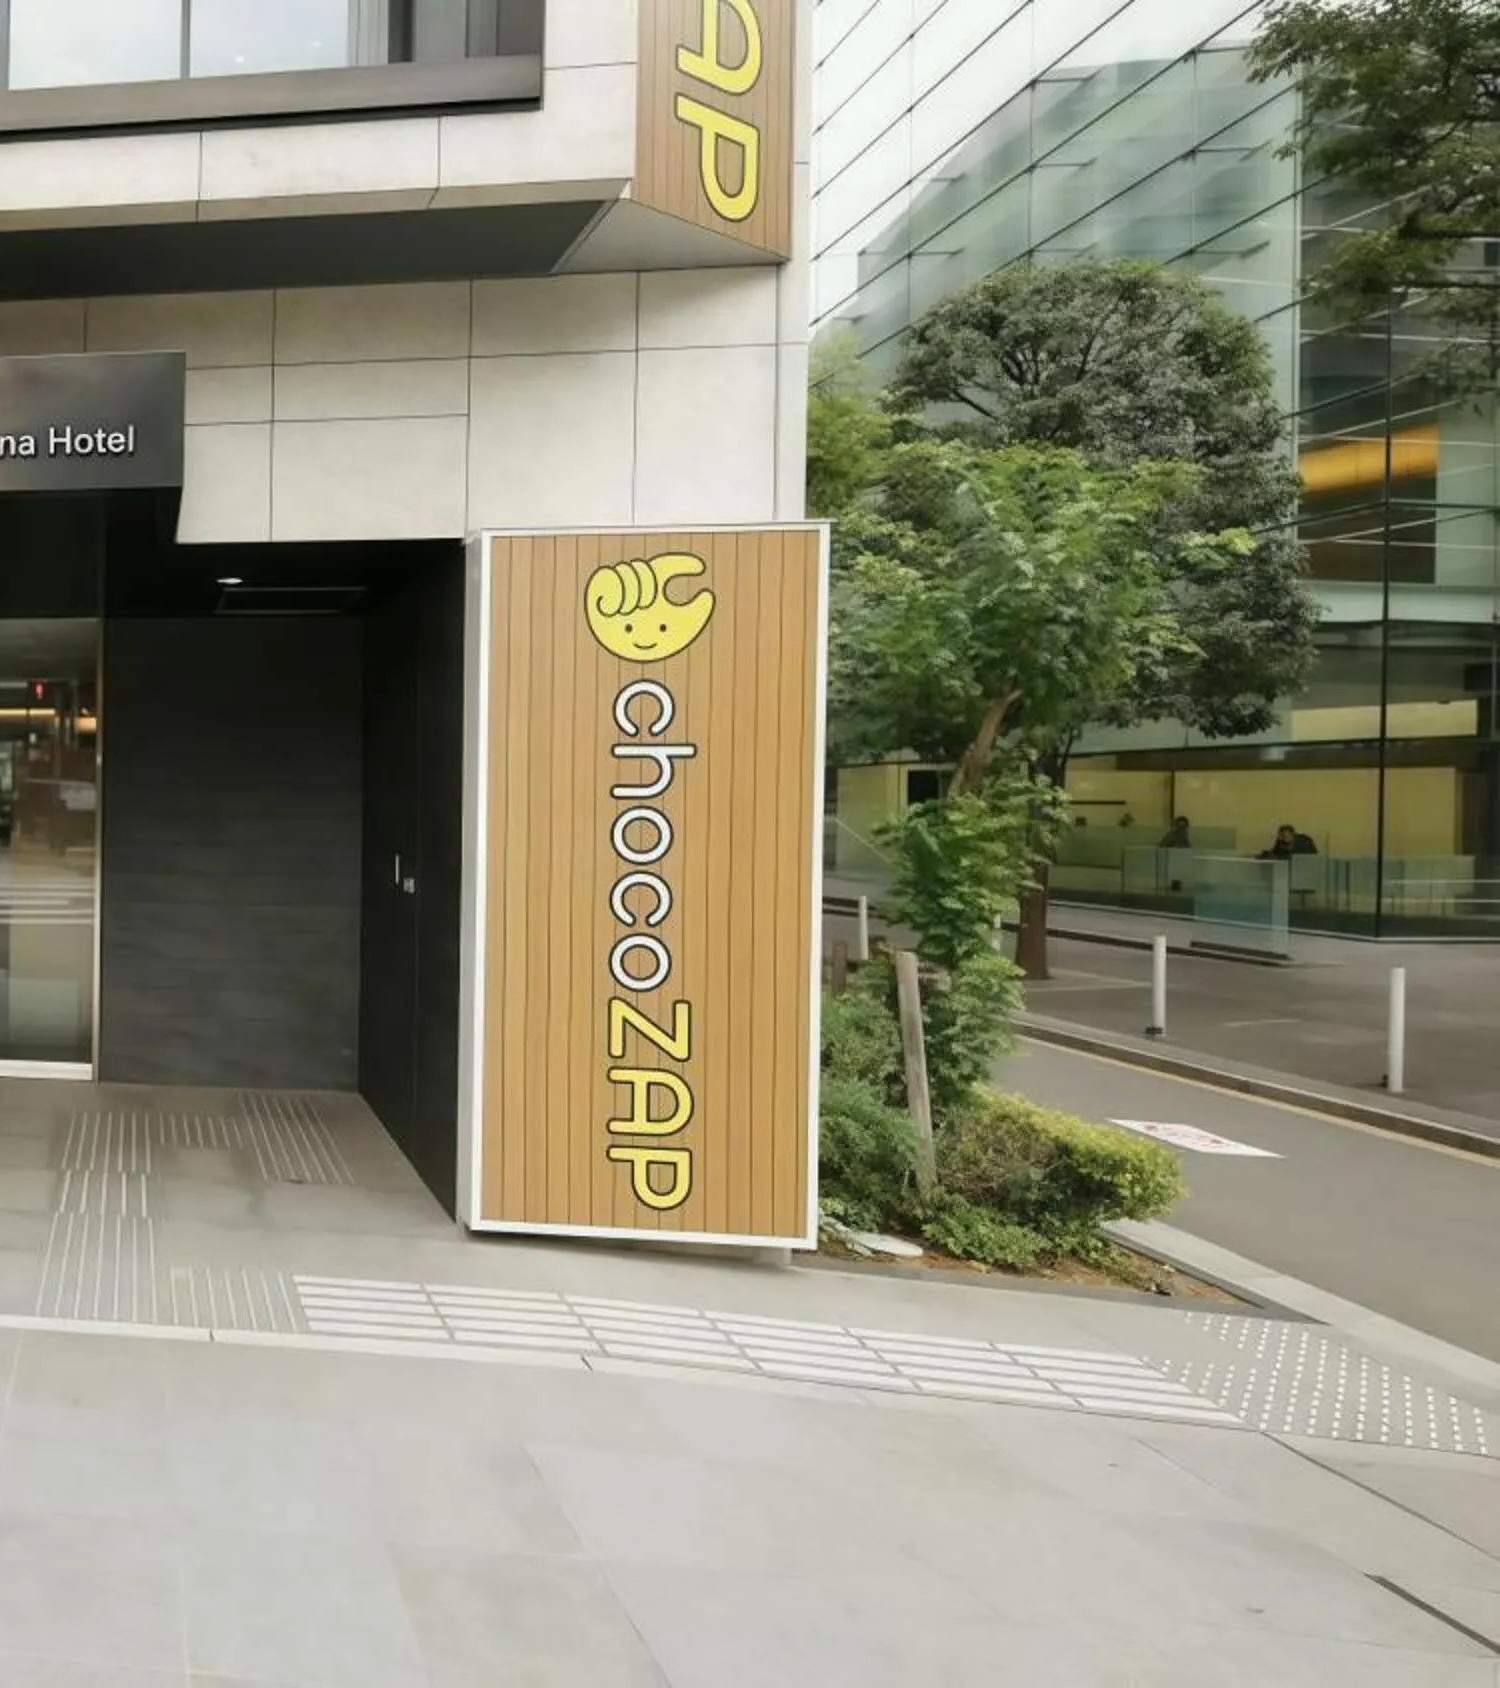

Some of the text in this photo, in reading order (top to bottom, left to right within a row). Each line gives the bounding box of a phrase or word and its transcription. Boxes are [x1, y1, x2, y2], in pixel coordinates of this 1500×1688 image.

[0, 434, 36, 456] na
[49, 424, 135, 455] Hotel
[606, 679, 697, 1210] chocoZAP
